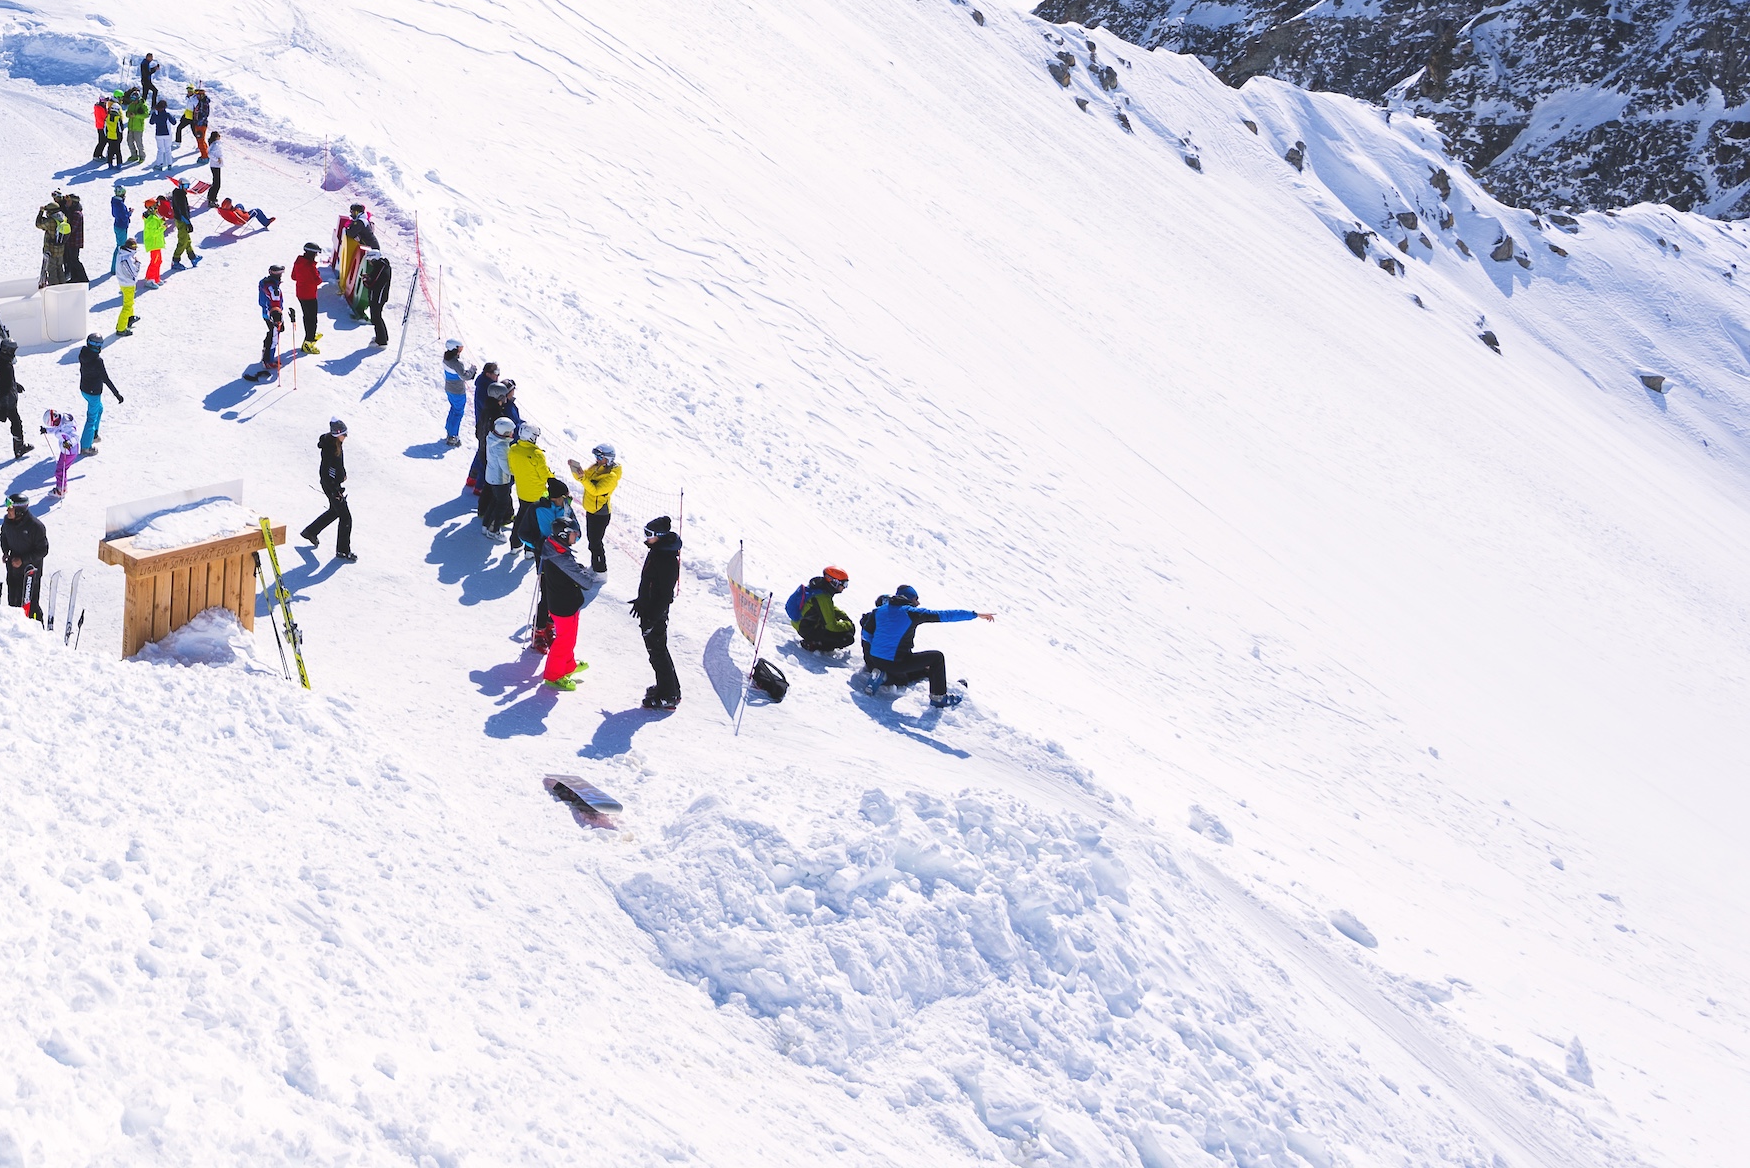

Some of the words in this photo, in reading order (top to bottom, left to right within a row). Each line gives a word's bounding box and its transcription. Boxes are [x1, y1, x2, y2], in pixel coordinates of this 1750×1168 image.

[139, 561, 168, 576] LIGNUM
[169, 555, 199, 570] SOMMER
[24, 576, 32, 603] ATOMIC
